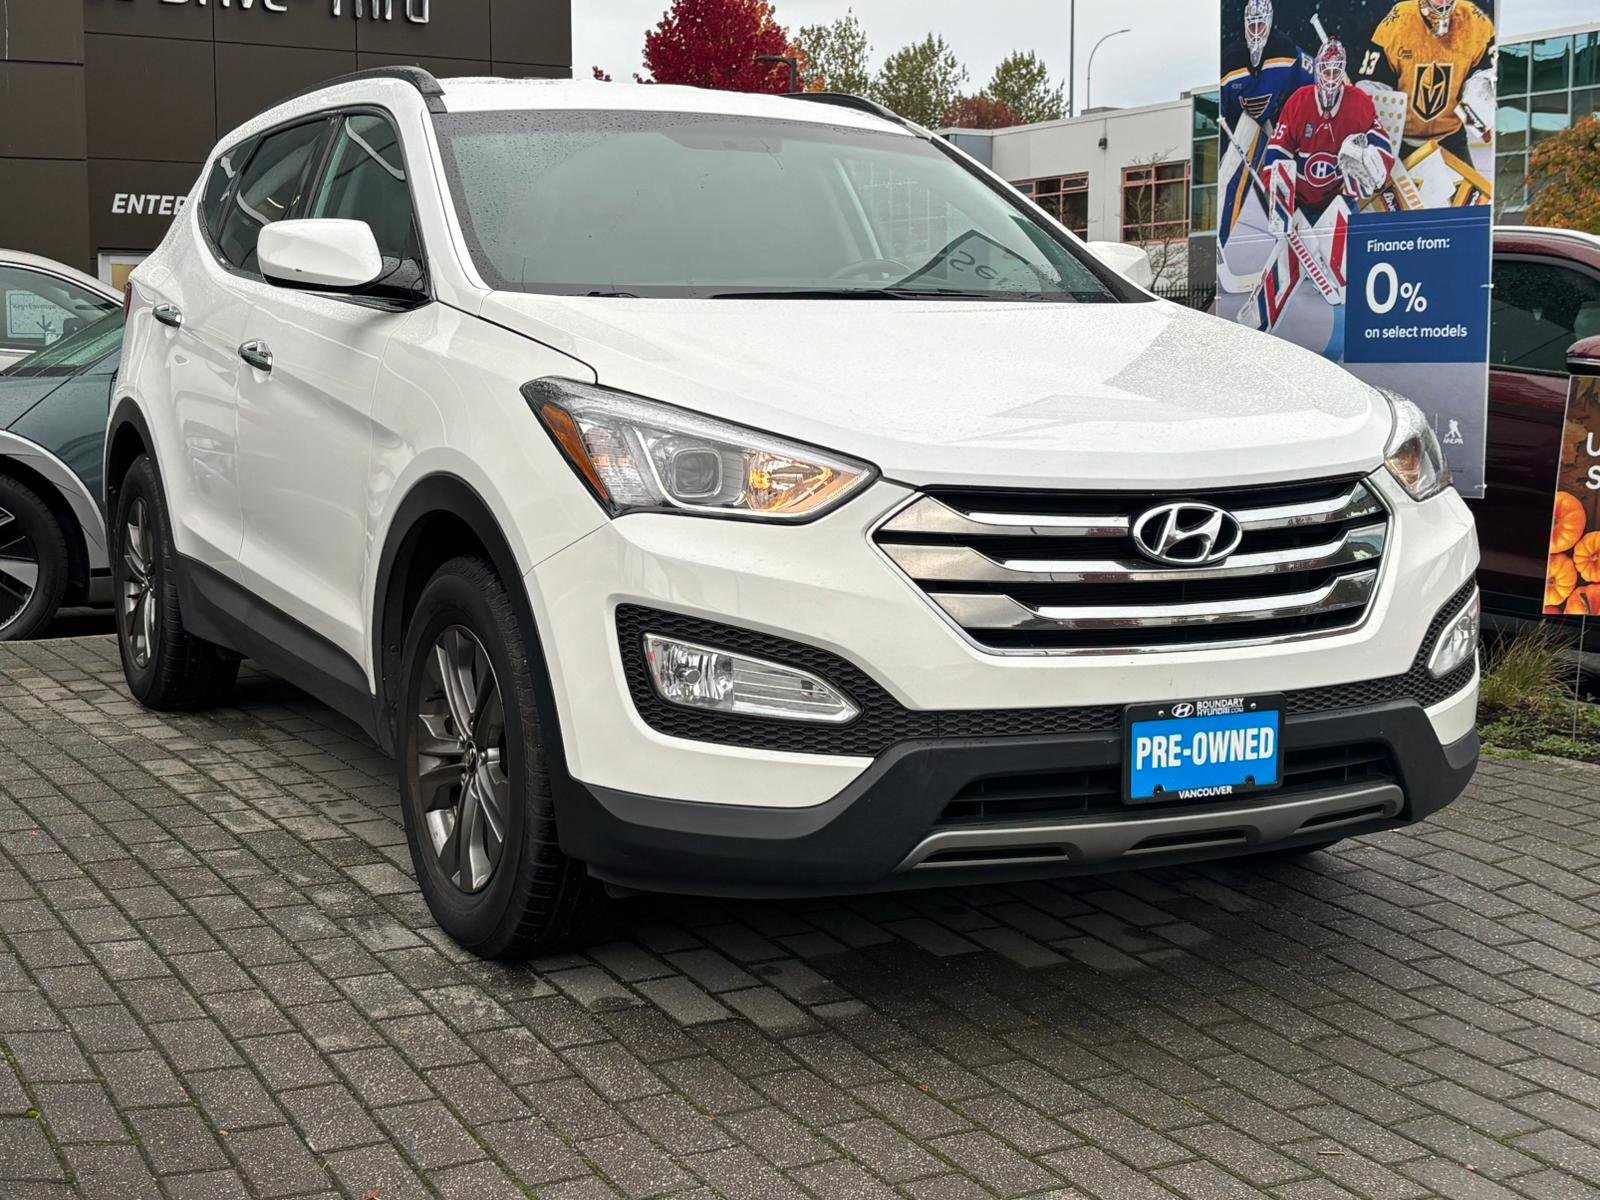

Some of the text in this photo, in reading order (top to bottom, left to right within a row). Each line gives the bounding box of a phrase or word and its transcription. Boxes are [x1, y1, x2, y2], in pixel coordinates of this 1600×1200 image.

[1367, 236, 1450, 252] Finance from:
[1366, 262, 1428, 314] 0%
[1364, 324, 1468, 338] on select models
[1196, 697, 1244, 709] BOUNDARY
[1136, 727, 1275, 771] PRE-OWNED
[1178, 785, 1233, 799] VANCOUVER
